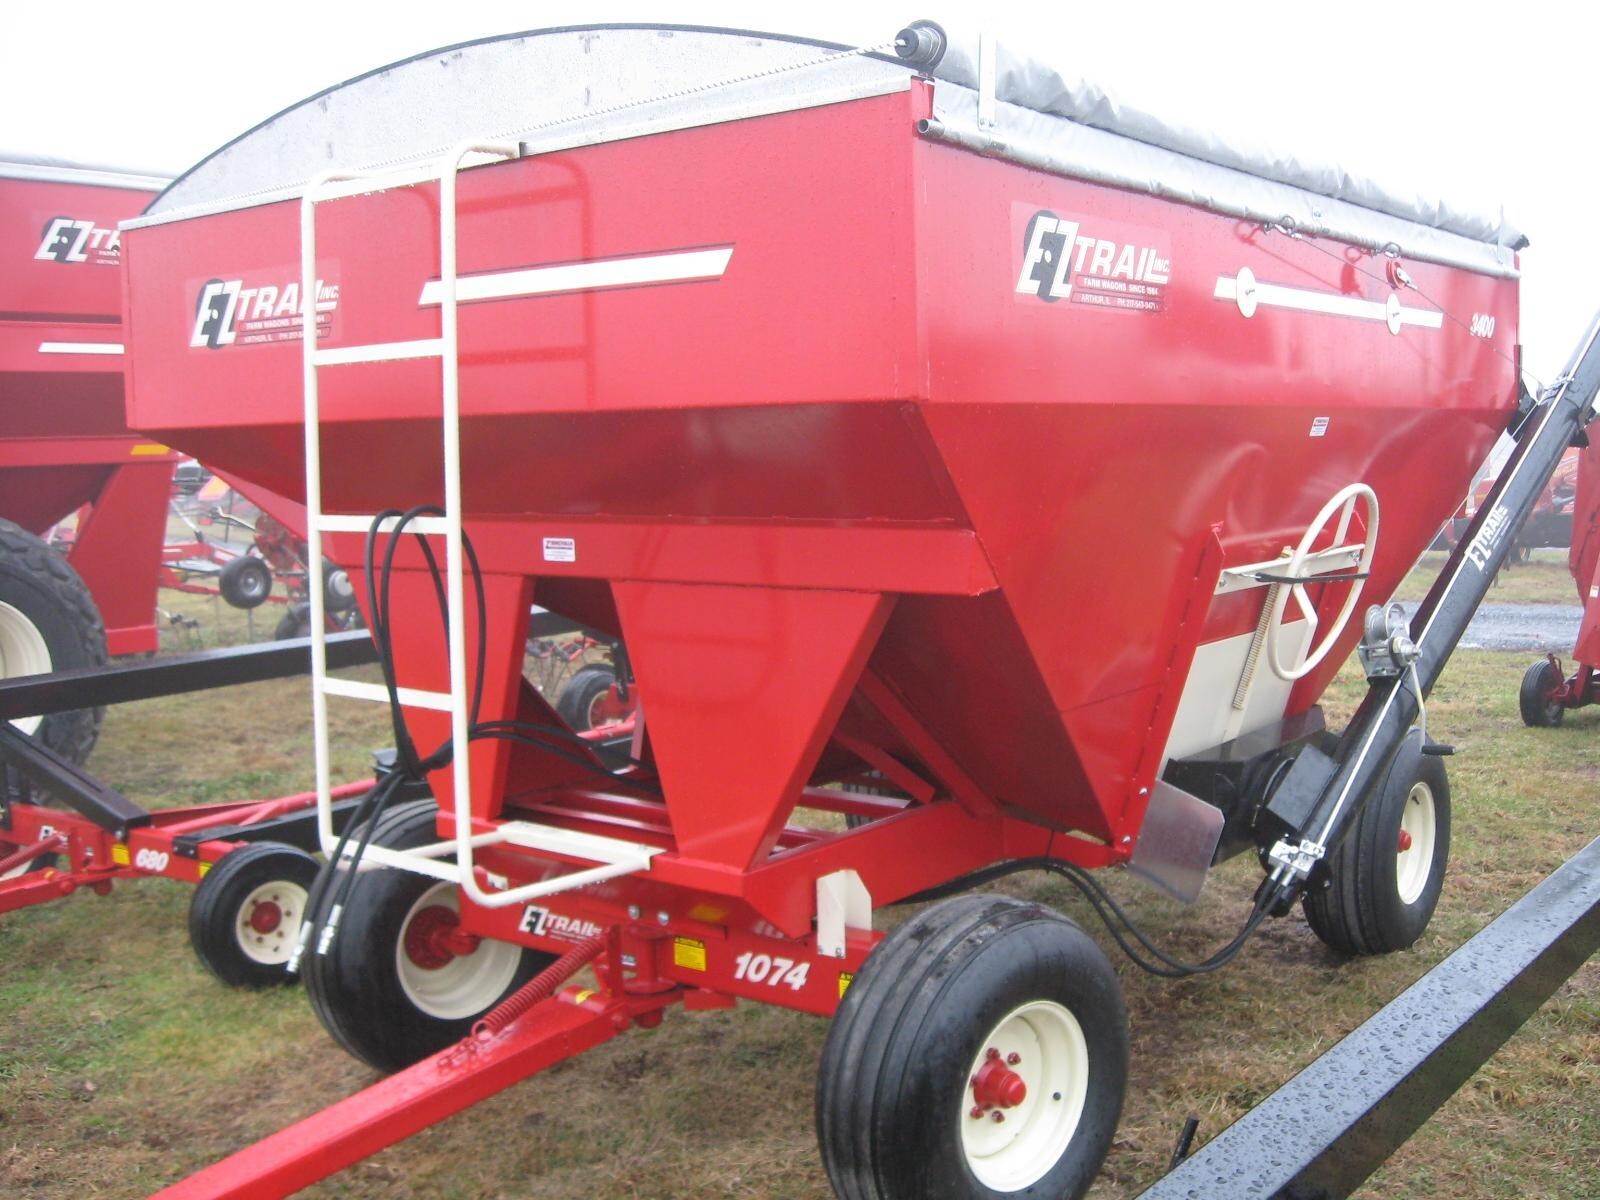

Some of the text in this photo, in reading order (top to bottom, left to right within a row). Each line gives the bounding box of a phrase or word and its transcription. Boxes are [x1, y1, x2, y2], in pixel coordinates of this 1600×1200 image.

[1073, 235, 1169, 285] TRAIL
[135, 847, 170, 872] 680
[546, 911, 595, 938] TRAIL
[734, 951, 811, 991] 1074
